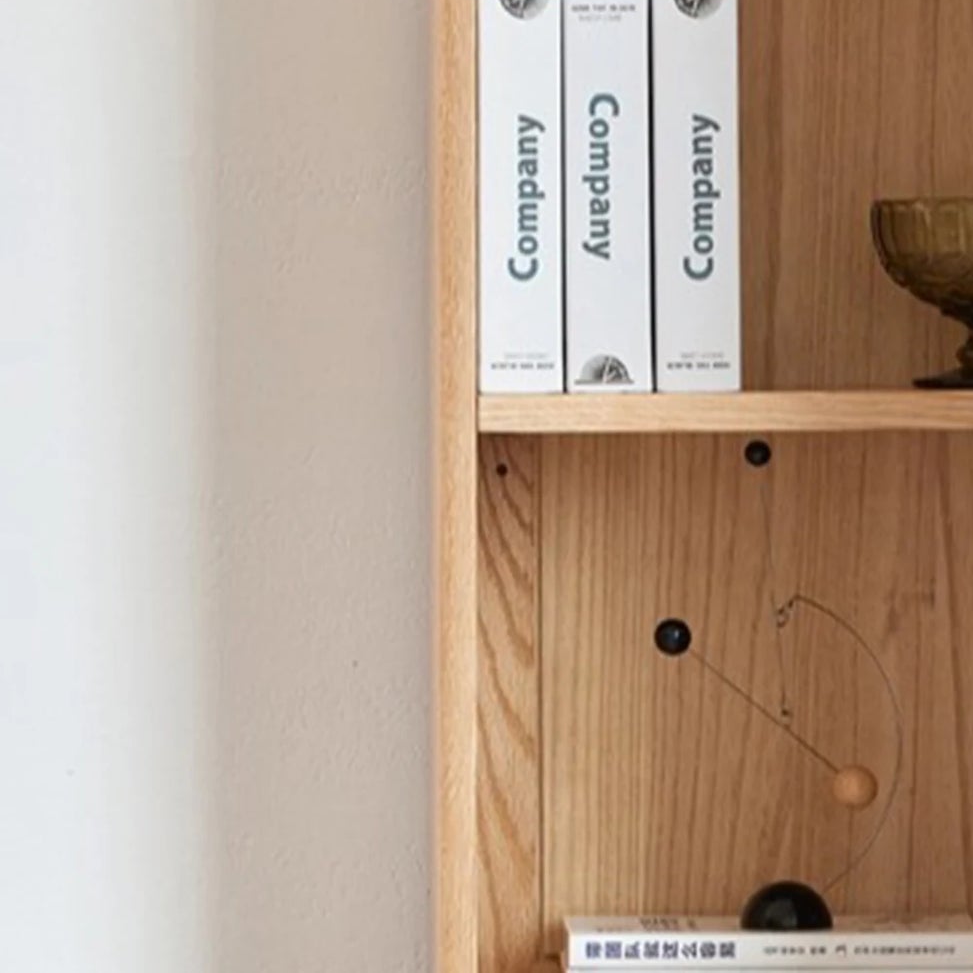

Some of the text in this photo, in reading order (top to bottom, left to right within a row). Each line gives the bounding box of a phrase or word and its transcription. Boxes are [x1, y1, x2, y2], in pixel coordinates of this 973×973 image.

[507, 114, 546, 281] Company
[582, 93, 620, 261] Company
[683, 114, 721, 281] Company
